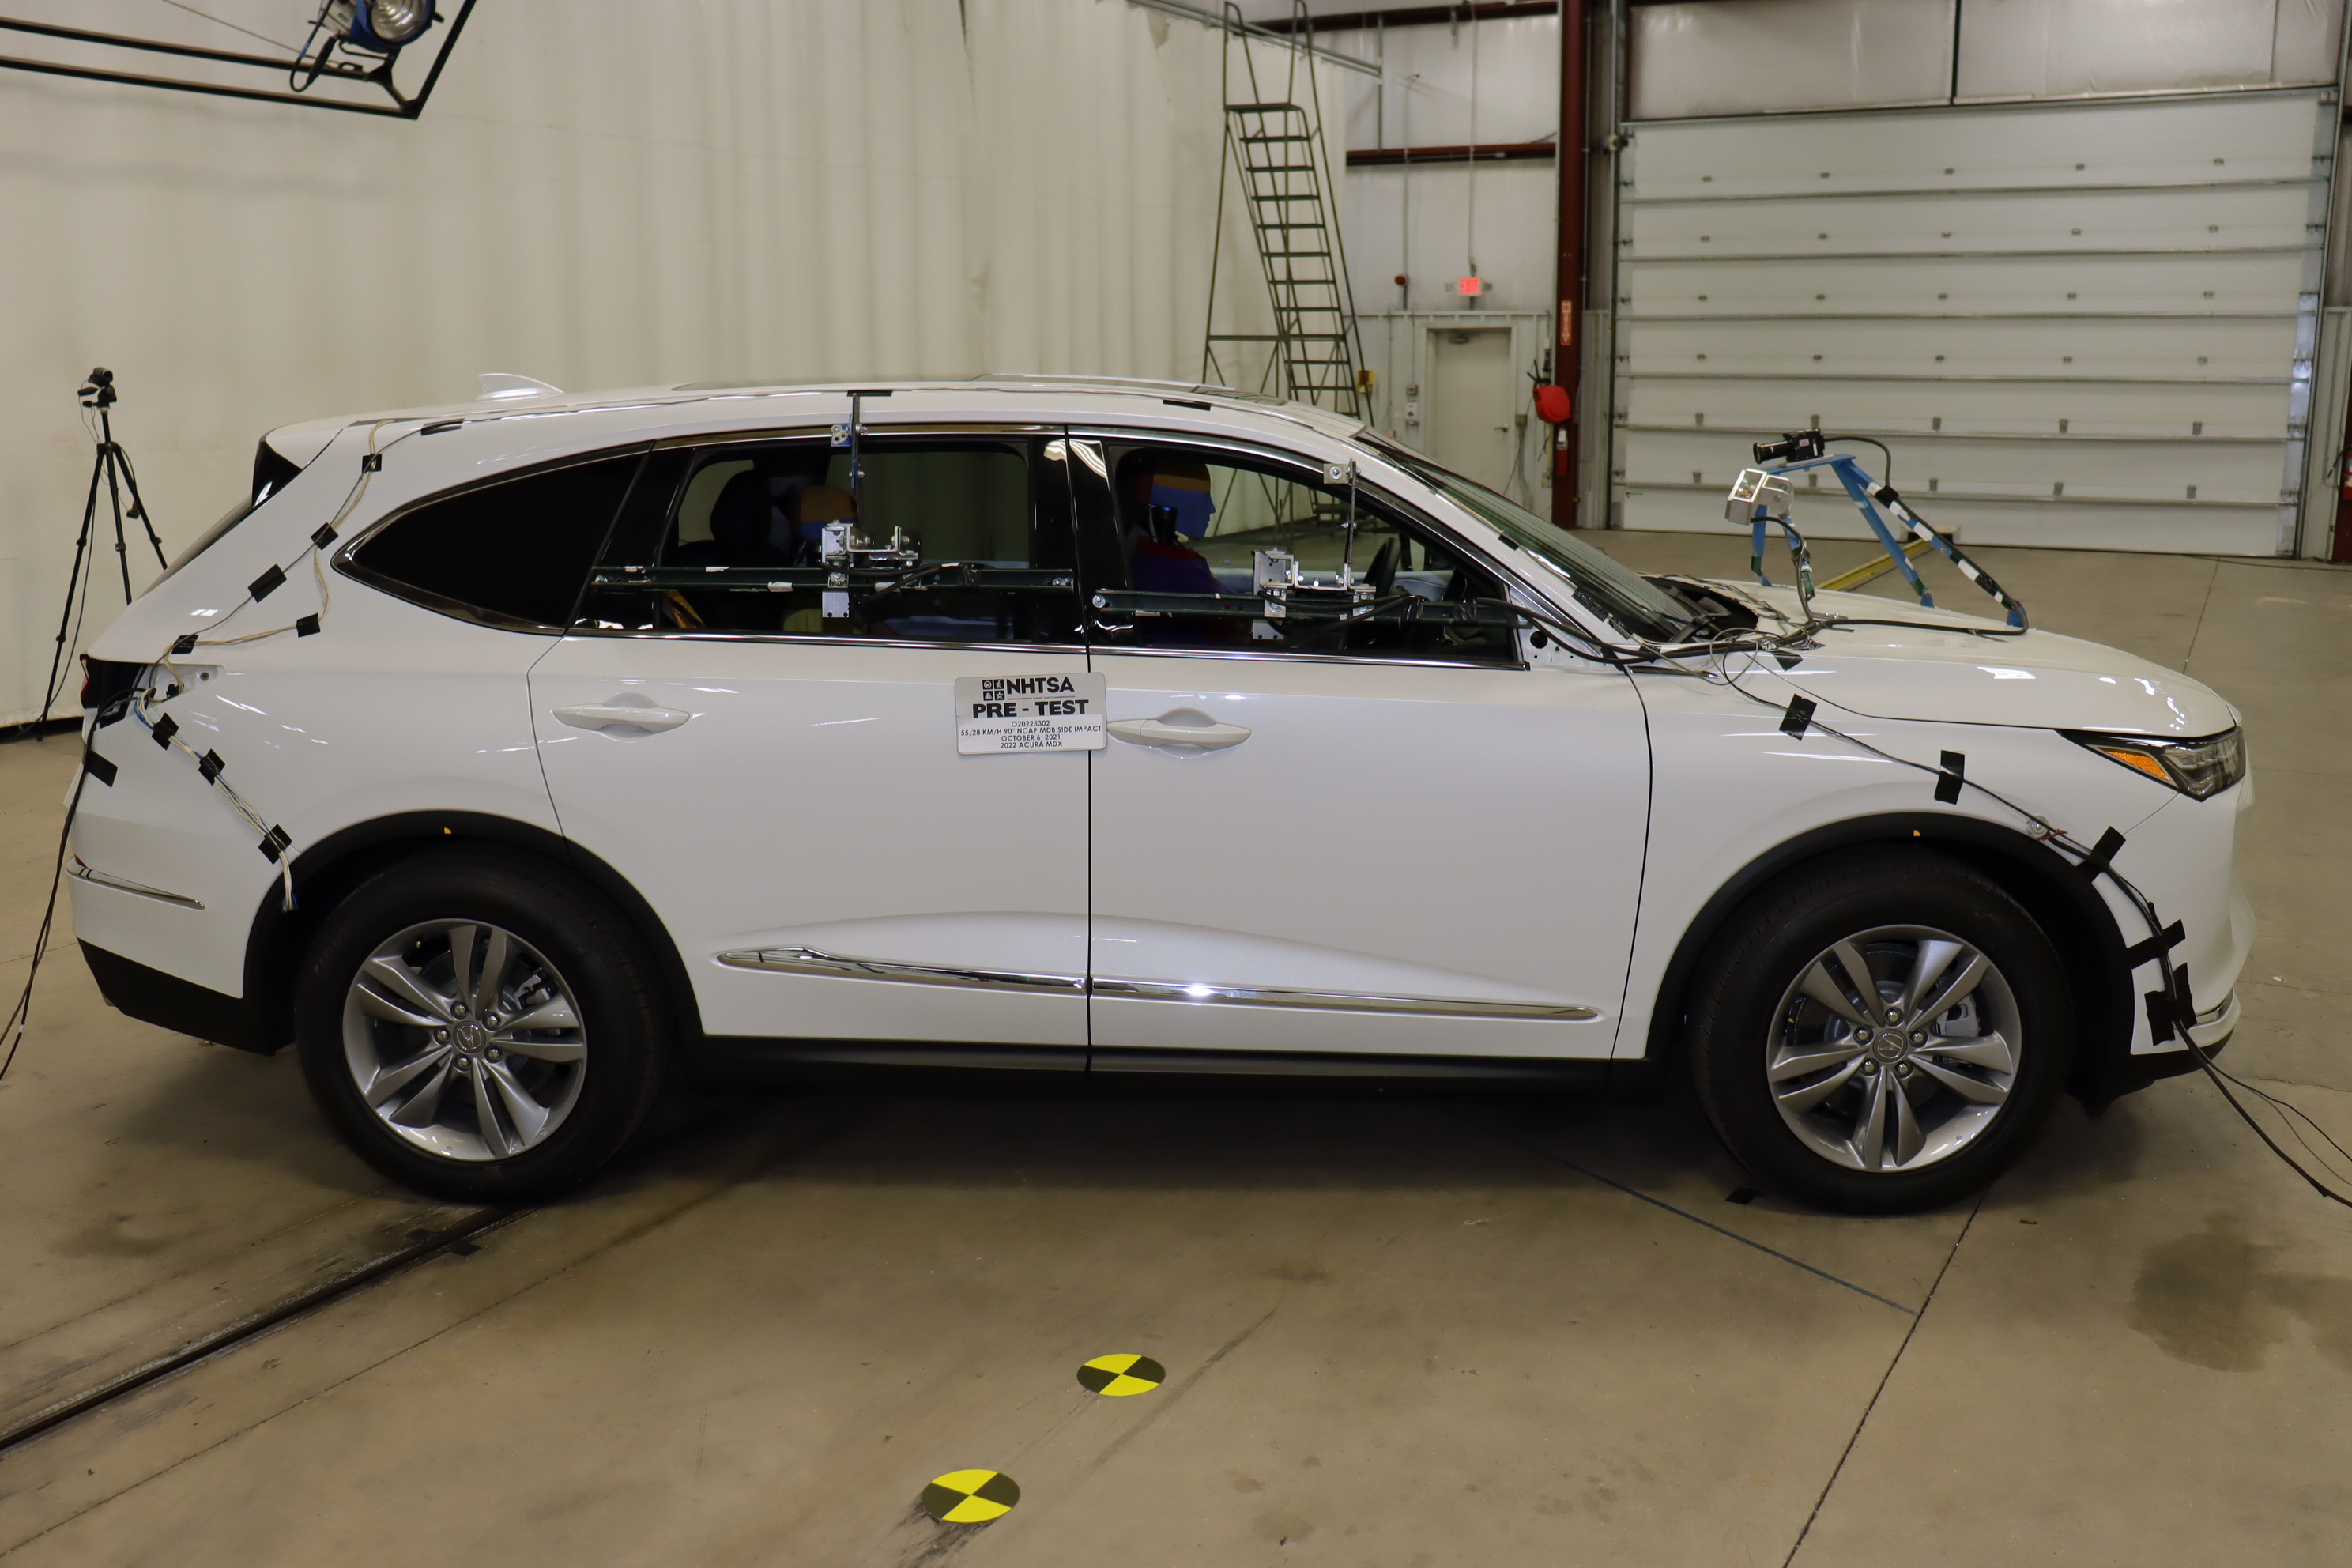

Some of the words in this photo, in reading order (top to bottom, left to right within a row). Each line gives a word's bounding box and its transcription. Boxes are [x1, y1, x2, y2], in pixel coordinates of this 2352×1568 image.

[1006, 677, 1075, 695] NHTSA
[973, 703, 1017, 718] PRE
[1035, 699, 1089, 716] TEST
